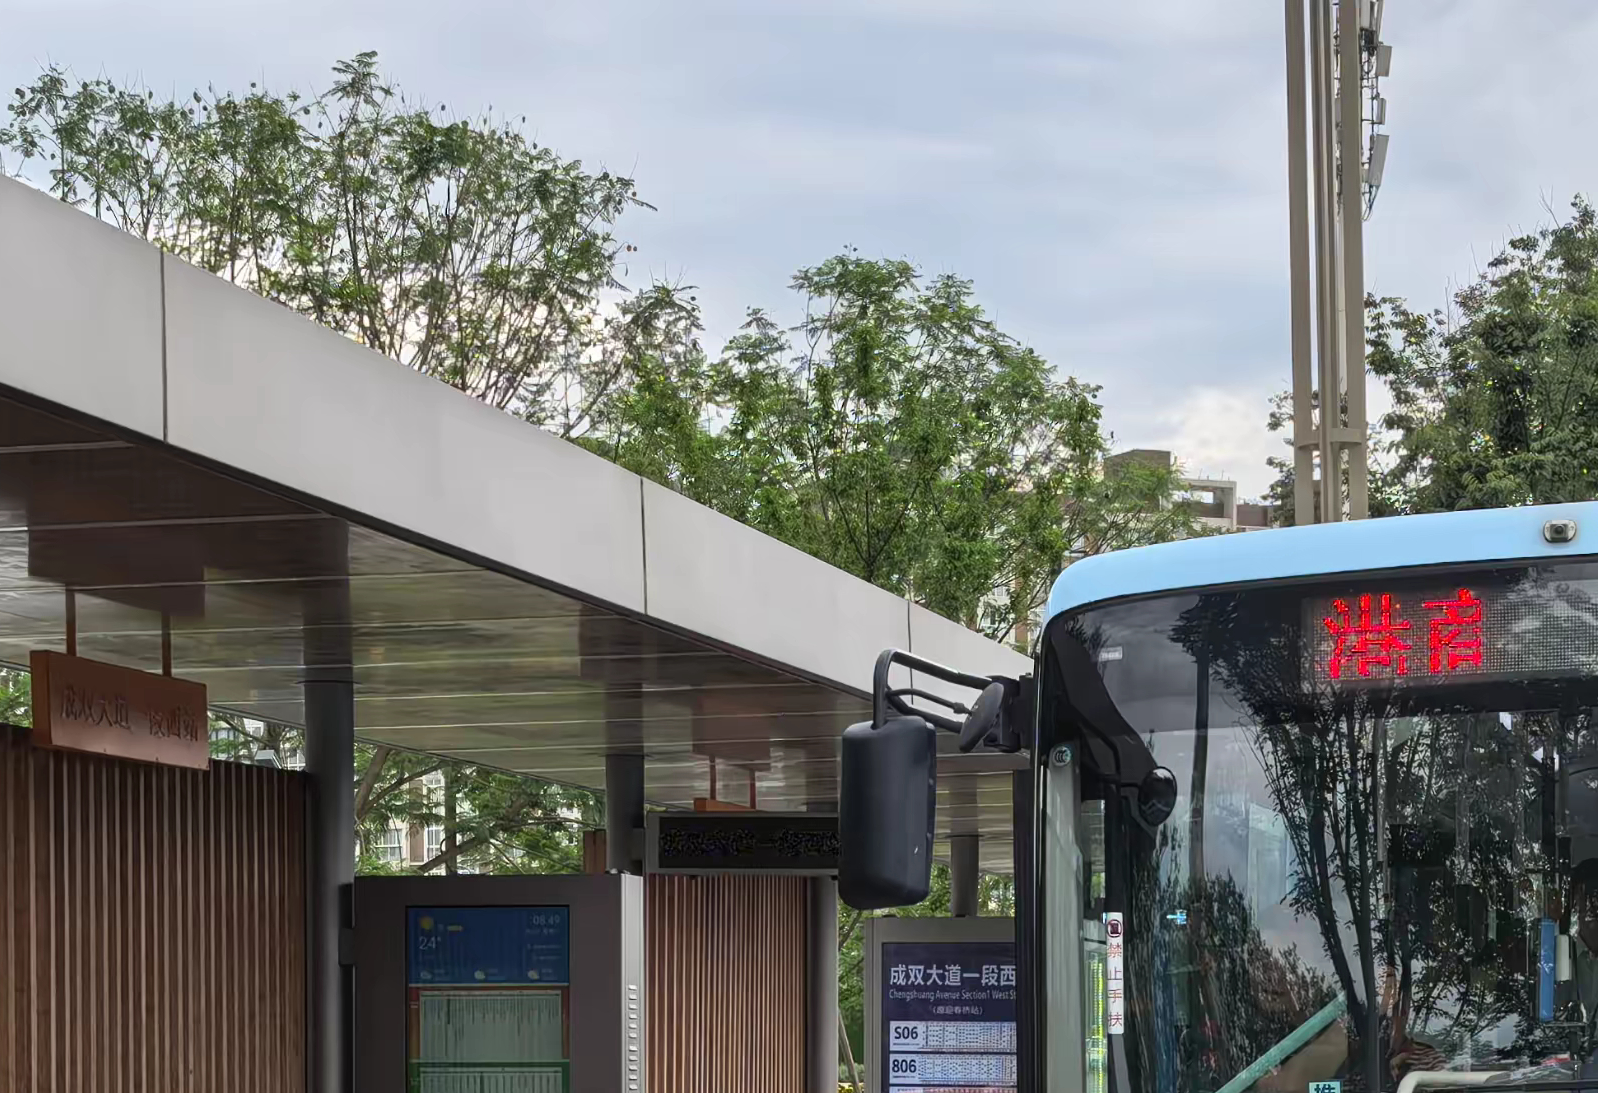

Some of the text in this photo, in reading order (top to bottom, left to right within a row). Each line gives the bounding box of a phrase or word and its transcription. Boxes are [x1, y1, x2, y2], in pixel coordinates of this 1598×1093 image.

[889, 963, 1016, 987] 成双大道一段西
[1107, 942, 1123, 1028] 禁止手扶
[894, 1026, 918, 1040] S06
[891, 1059, 917, 1073] 806
